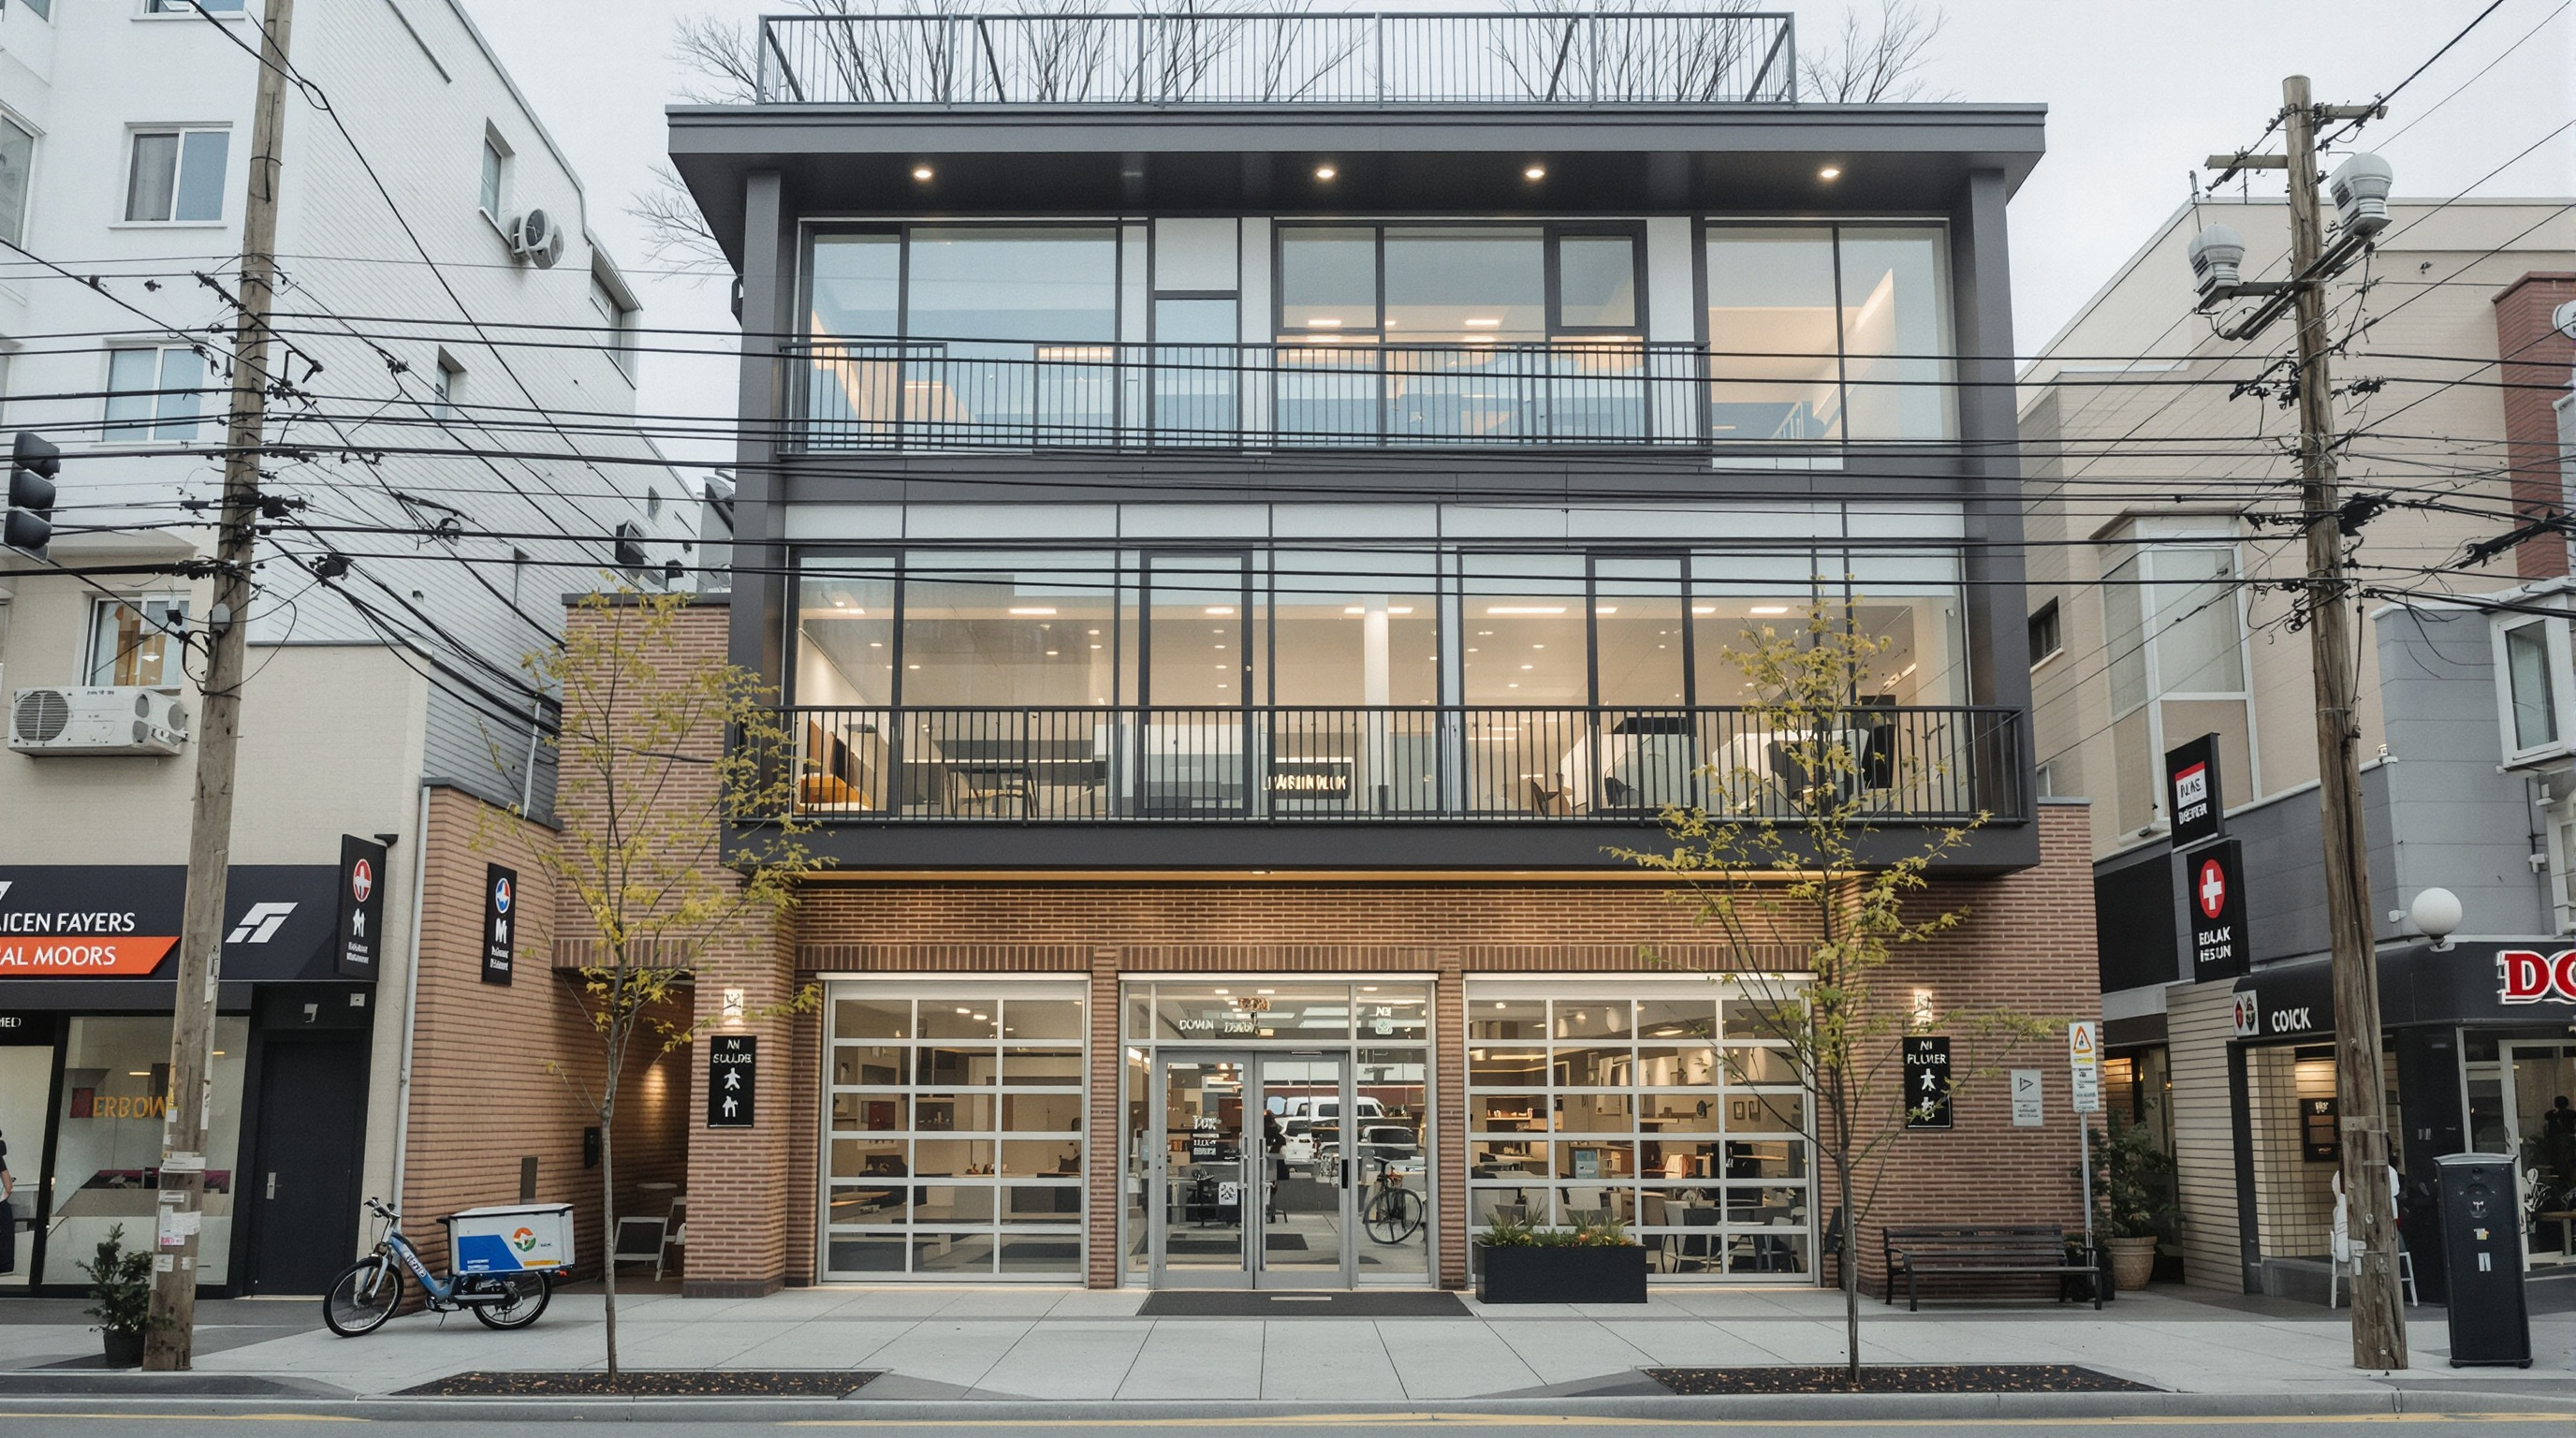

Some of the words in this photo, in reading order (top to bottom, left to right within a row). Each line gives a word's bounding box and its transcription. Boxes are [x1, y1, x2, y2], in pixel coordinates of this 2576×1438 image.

[0, 913, 51, 932] ICEN
[56, 912, 136, 932] FAYERS
[0, 946, 28, 965] AL
[33, 946, 117, 966] MOORS
[2272, 1007, 2312, 1033] COICK
